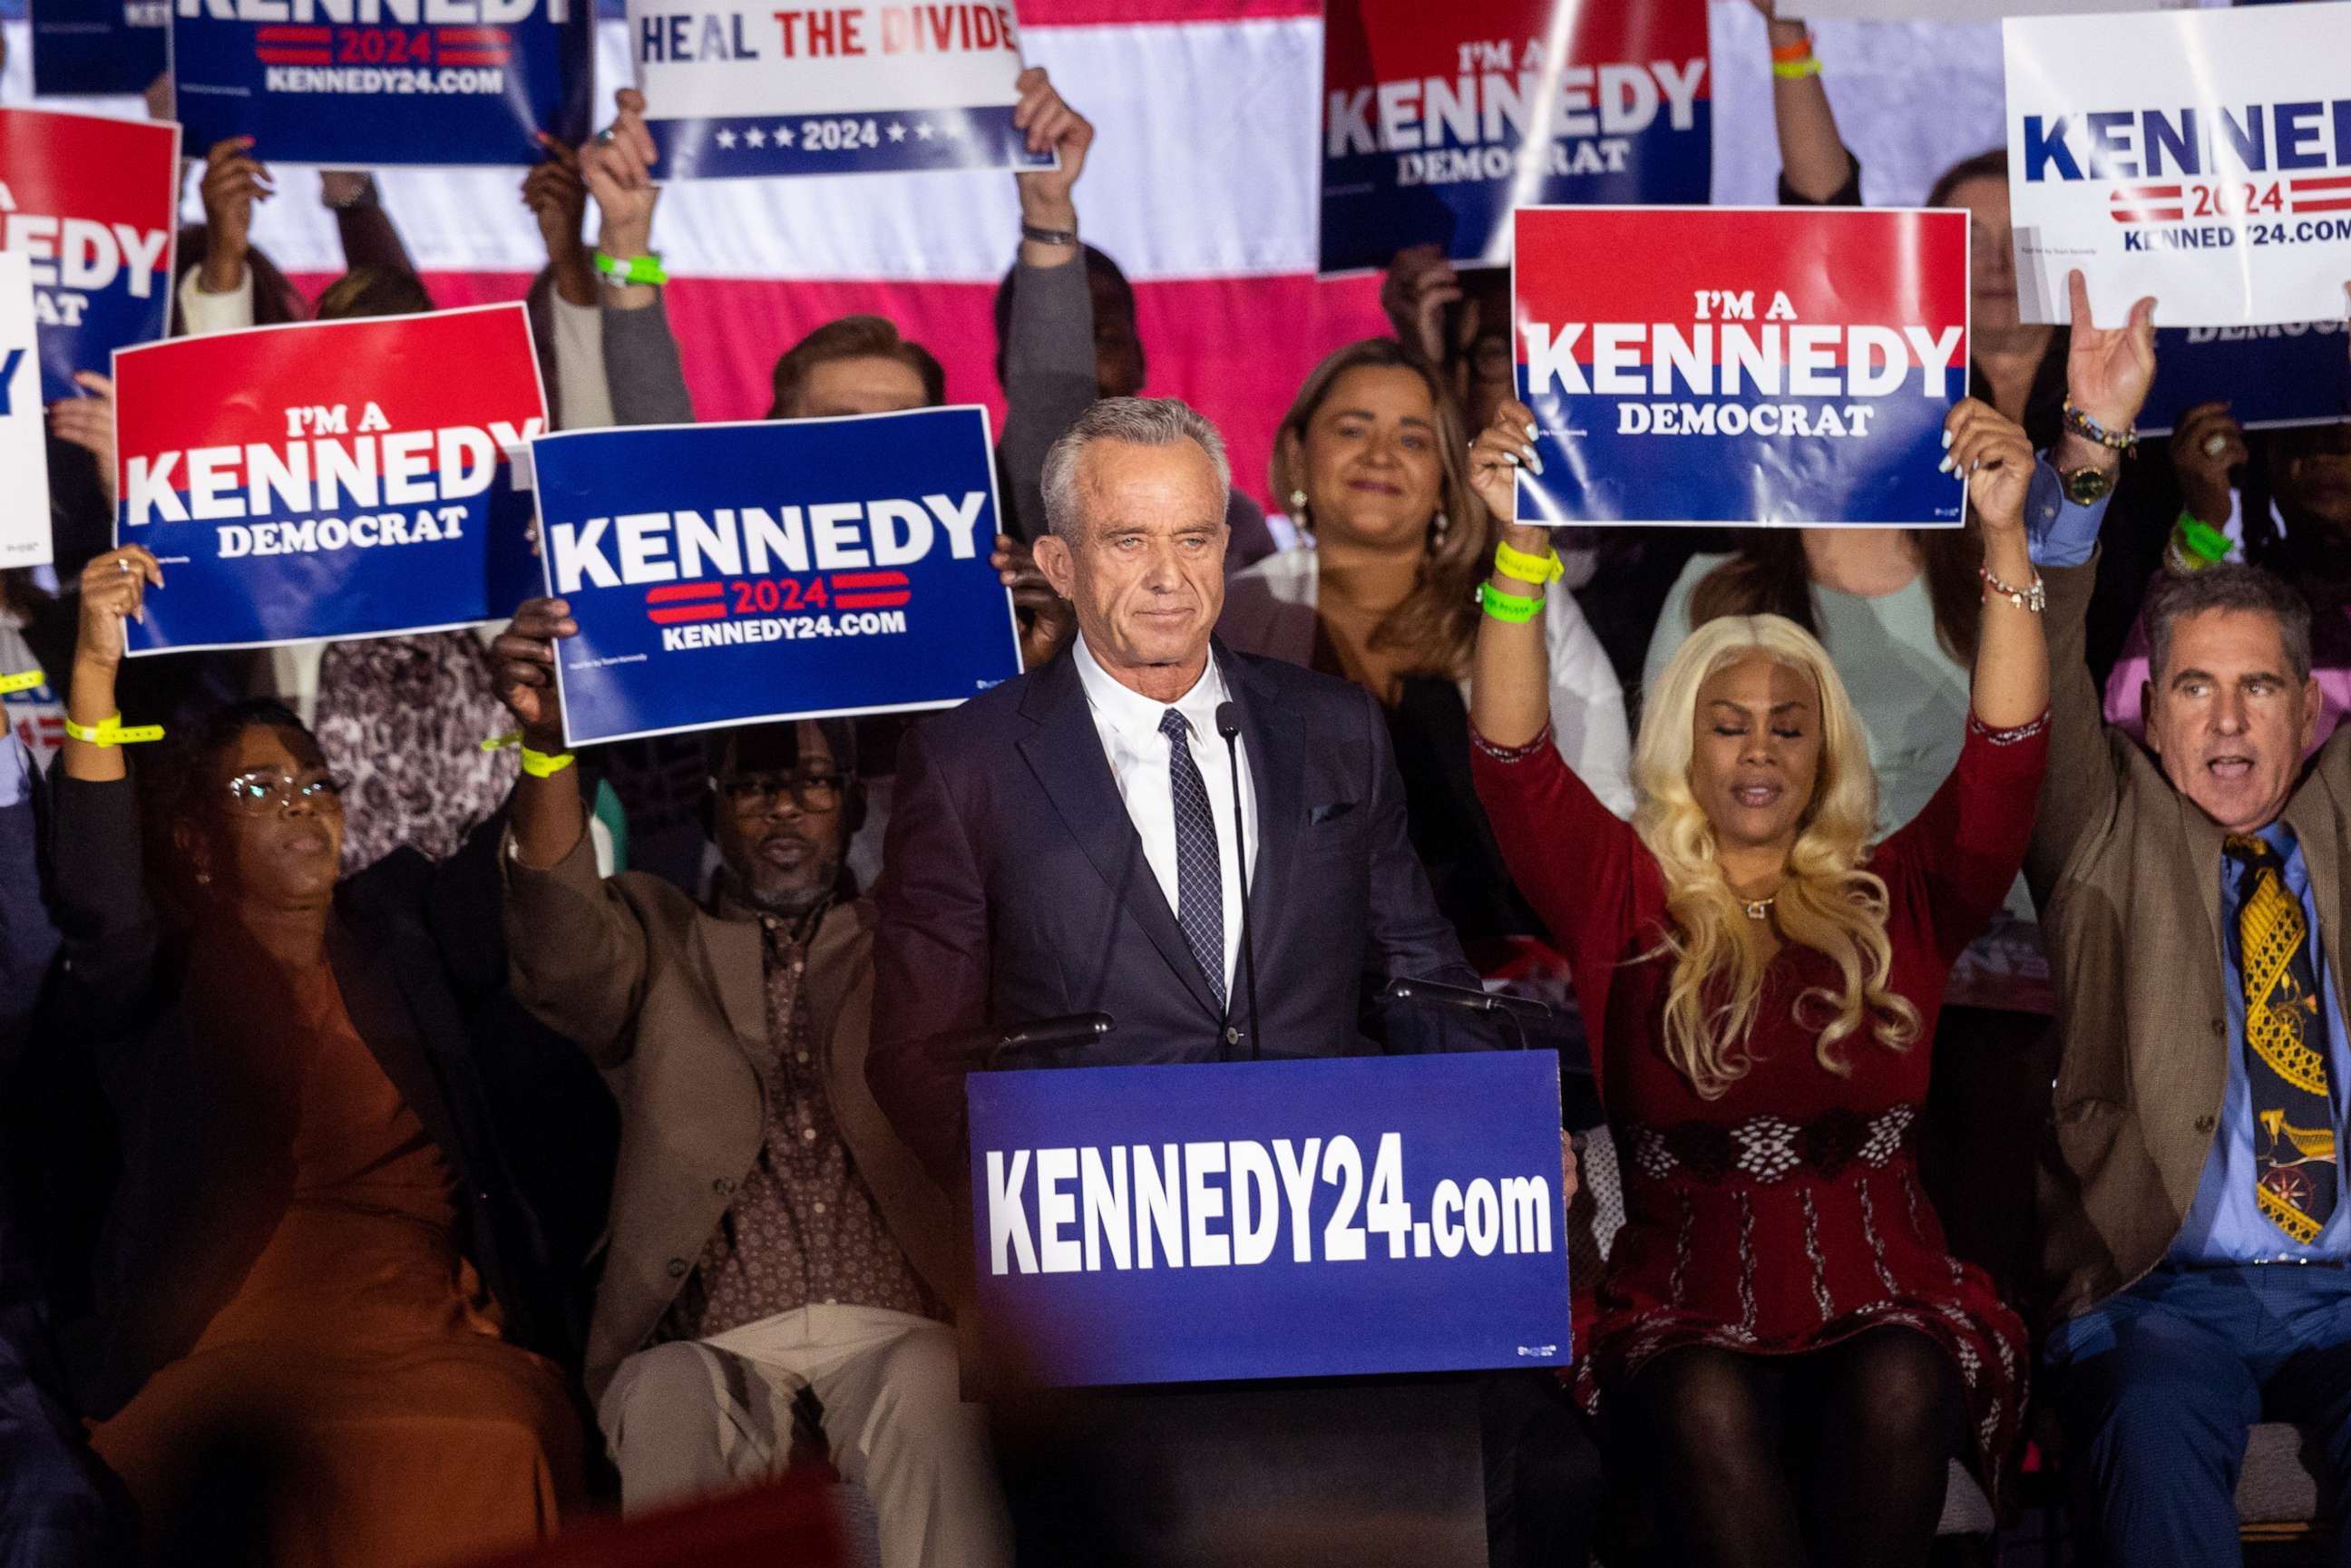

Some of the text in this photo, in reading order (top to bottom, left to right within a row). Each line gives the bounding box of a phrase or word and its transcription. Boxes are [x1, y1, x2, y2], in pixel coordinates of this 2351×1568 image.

[337, 28, 432, 63] 2024
[641, 4, 1016, 63] HEAL THE DIVIDE
[1521, 36, 1550, 71] A
[266, 67, 502, 93] KENNEDY24.COM
[1327, 58, 1708, 159] KENNEDY
[802, 119, 879, 151] 2024
[1694, 290, 1796, 320] I'M A
[1527, 322, 1964, 398] KENNEDY
[286, 402, 391, 438] I'M A
[1617, 402, 1874, 437] DEMOCRAT
[127, 417, 545, 527] KENNEDY
[218, 505, 468, 559] DEMOCRAT
[550, 491, 987, 594] KENNEDY
[731, 577, 829, 614] 2024
[661, 610, 907, 652] KENNEDY24.COM
[985, 1132, 1553, 1276] KENNEDY24.com
